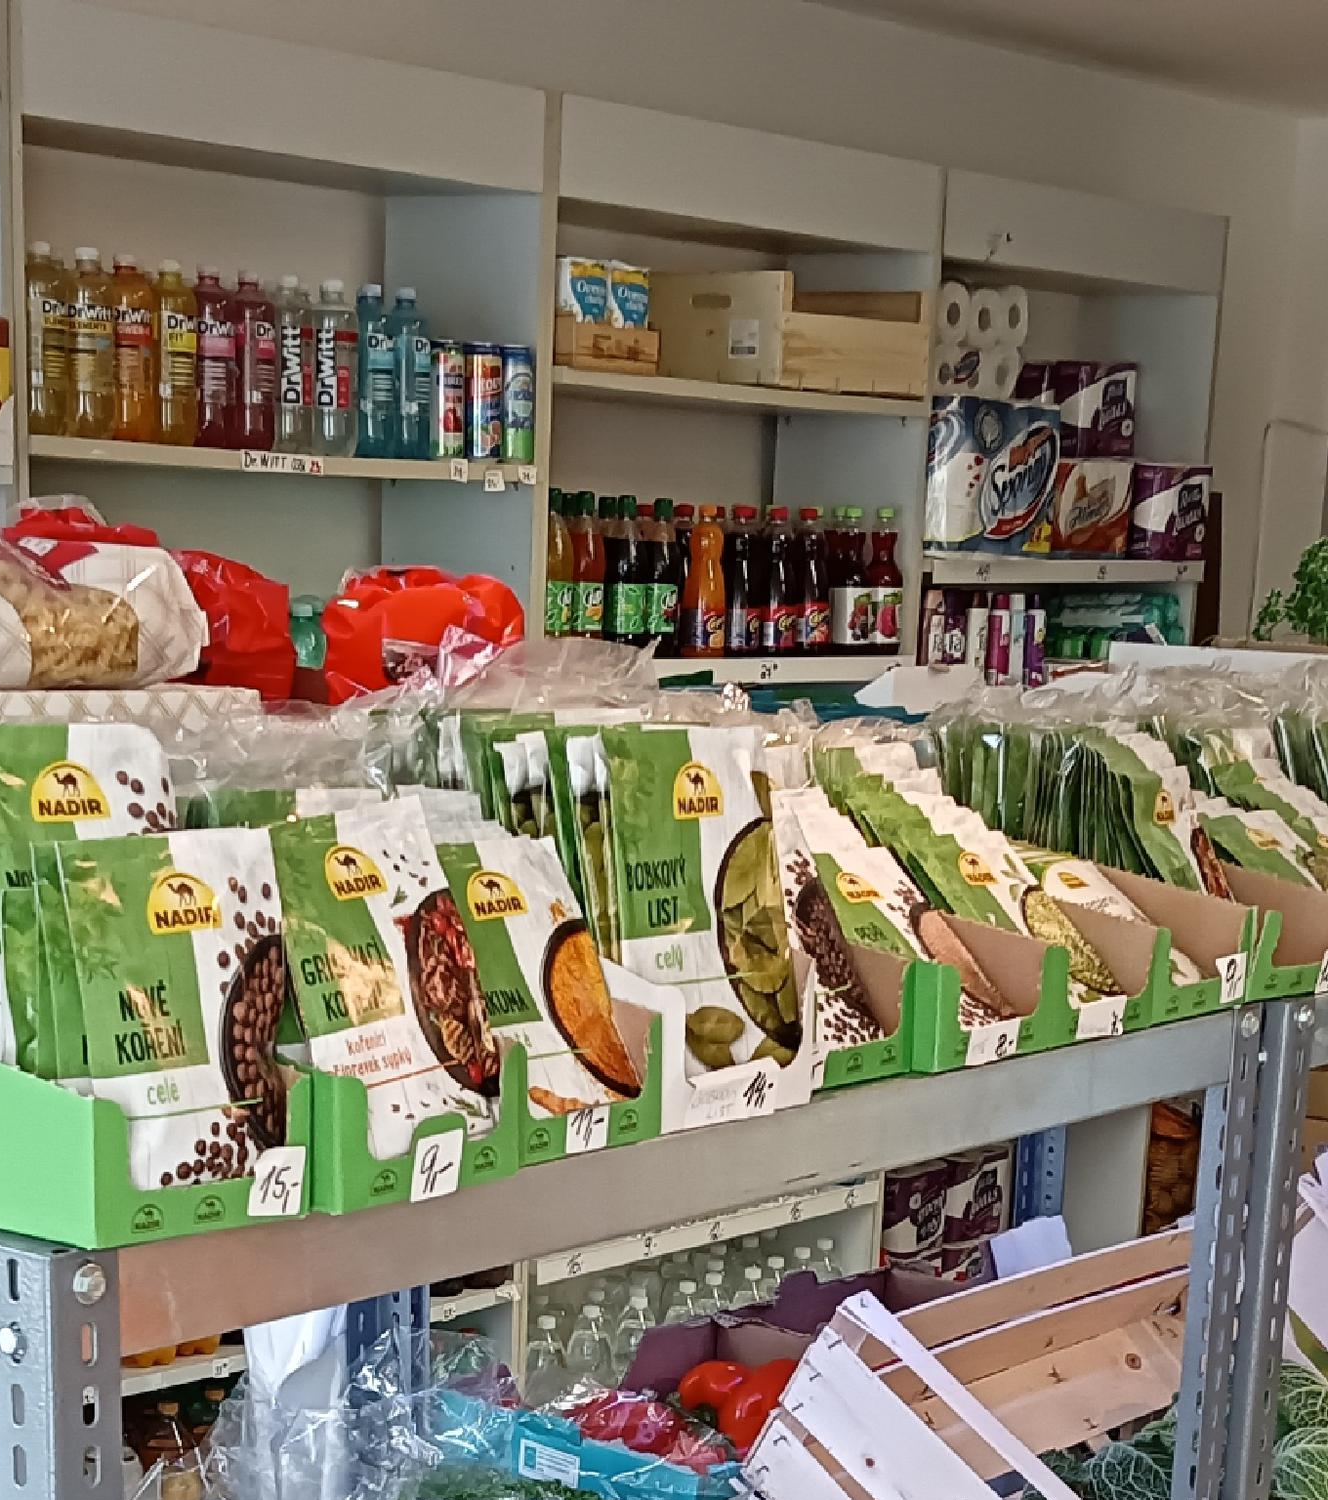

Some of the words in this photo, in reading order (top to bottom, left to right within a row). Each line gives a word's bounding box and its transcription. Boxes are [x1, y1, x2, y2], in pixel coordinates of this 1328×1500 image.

[38, 796, 103, 819] NADIR
[676, 793, 722, 816] NADIR
[333, 873, 383, 896] NADIR
[624, 851, 687, 894] BOBKOVÝ
[155, 906, 219, 931] NADIR
[473, 898, 524, 918] NADIR
[646, 896, 680, 929] LIST
[654, 945, 685, 973] celý
[146, 1079, 180, 1105] celé
